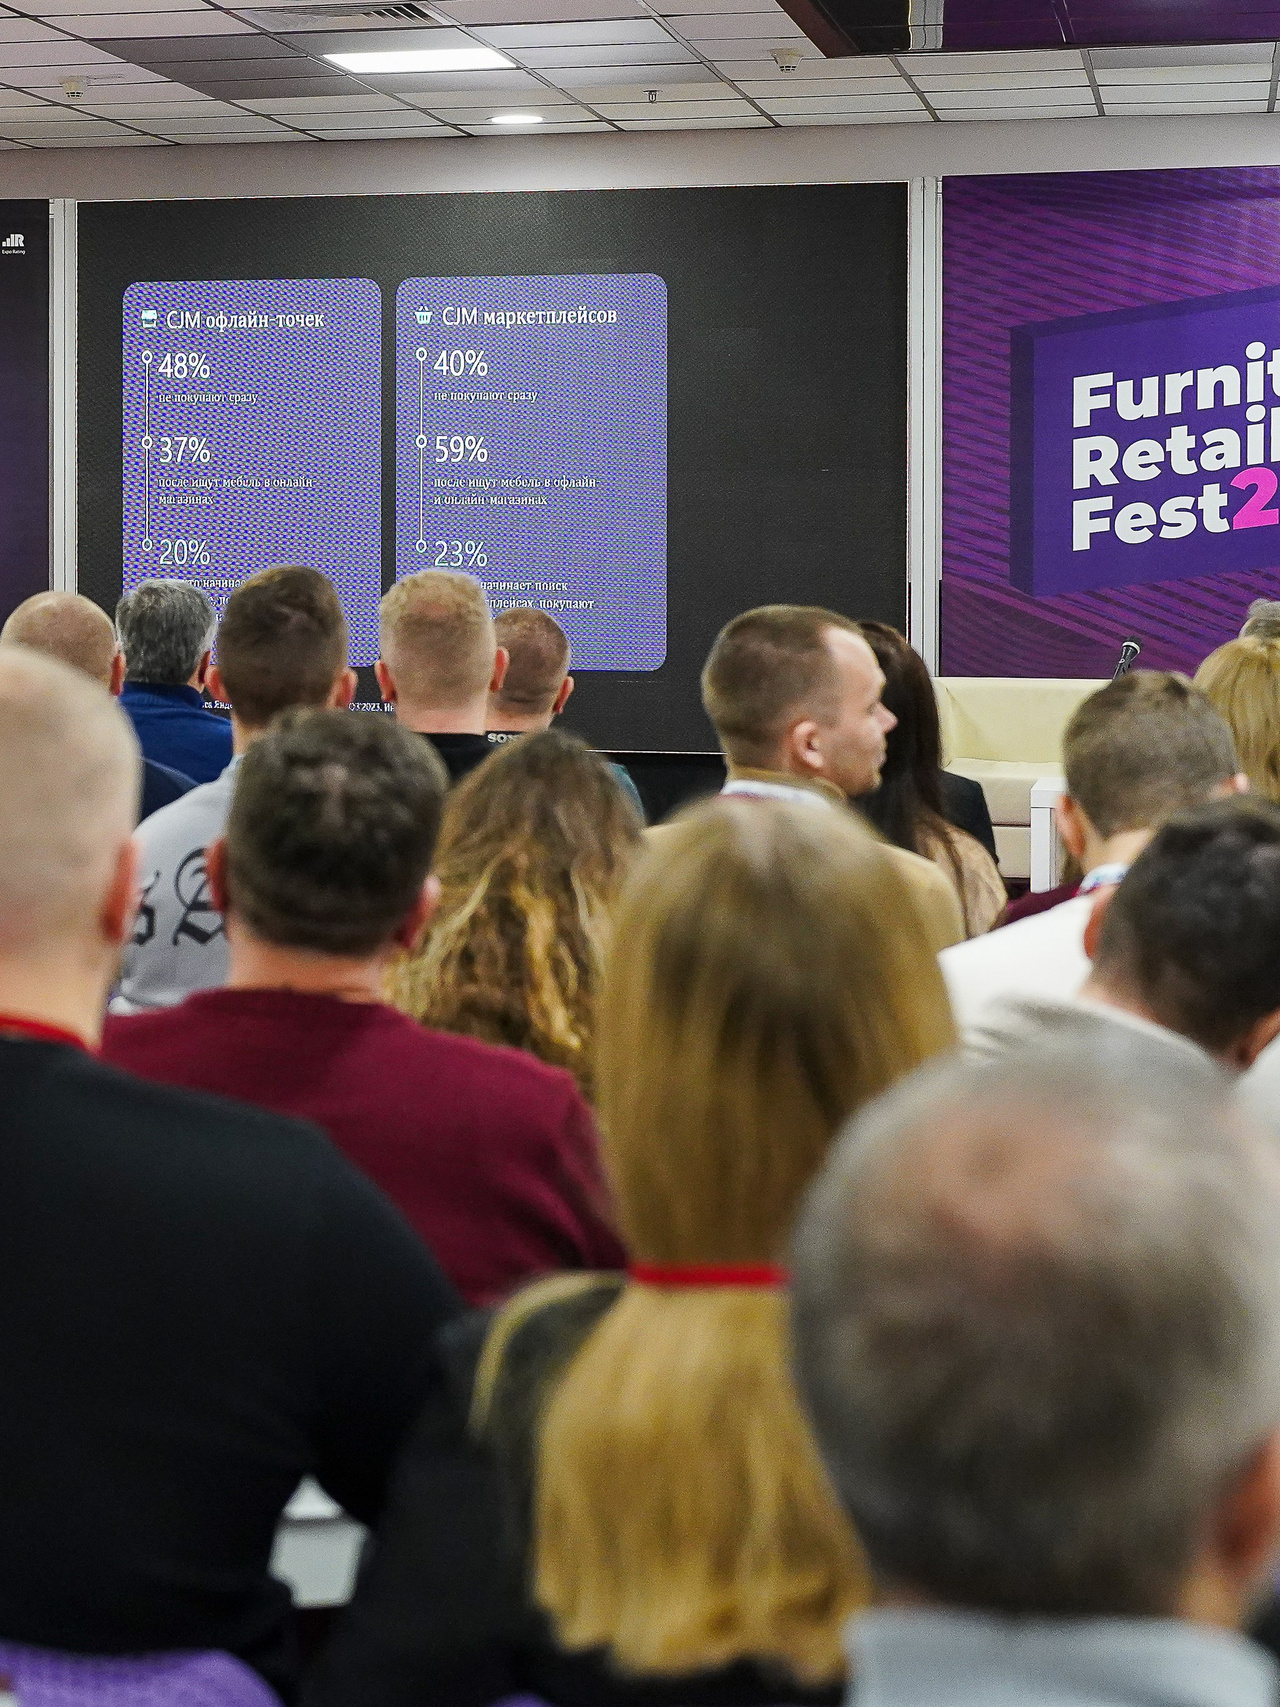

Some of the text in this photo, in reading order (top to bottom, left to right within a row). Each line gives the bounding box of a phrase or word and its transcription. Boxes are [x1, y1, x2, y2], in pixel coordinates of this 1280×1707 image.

[166, 310, 325, 332] CJM офлайн-точек
[442, 306, 618, 328] CJM маркетплейсов
[157, 352, 211, 379] 48%
[433, 349, 489, 377] 40%
[158, 393, 259, 406] не покупают сразу
[433, 391, 539, 404] не покупают сразу
[158, 436, 211, 463] 37%
[434, 435, 489, 463] 59%
[158, 478, 190, 488] после
[192, 478, 220, 490] ищут
[222, 476, 261, 488] мебель
[264, 478, 271, 487] в
[433, 478, 466, 488] после
[468, 478, 498, 490] ищут
[500, 475, 541, 488] мебель
[544, 478, 551, 488] в
[158, 495, 214, 505] магазинах
[433, 496, 441, 505] и
[158, 538, 211, 565] 20%
[434, 540, 489, 567] 23%
[535, 581, 569, 591] поиск
[539, 599, 594, 612] покупают
